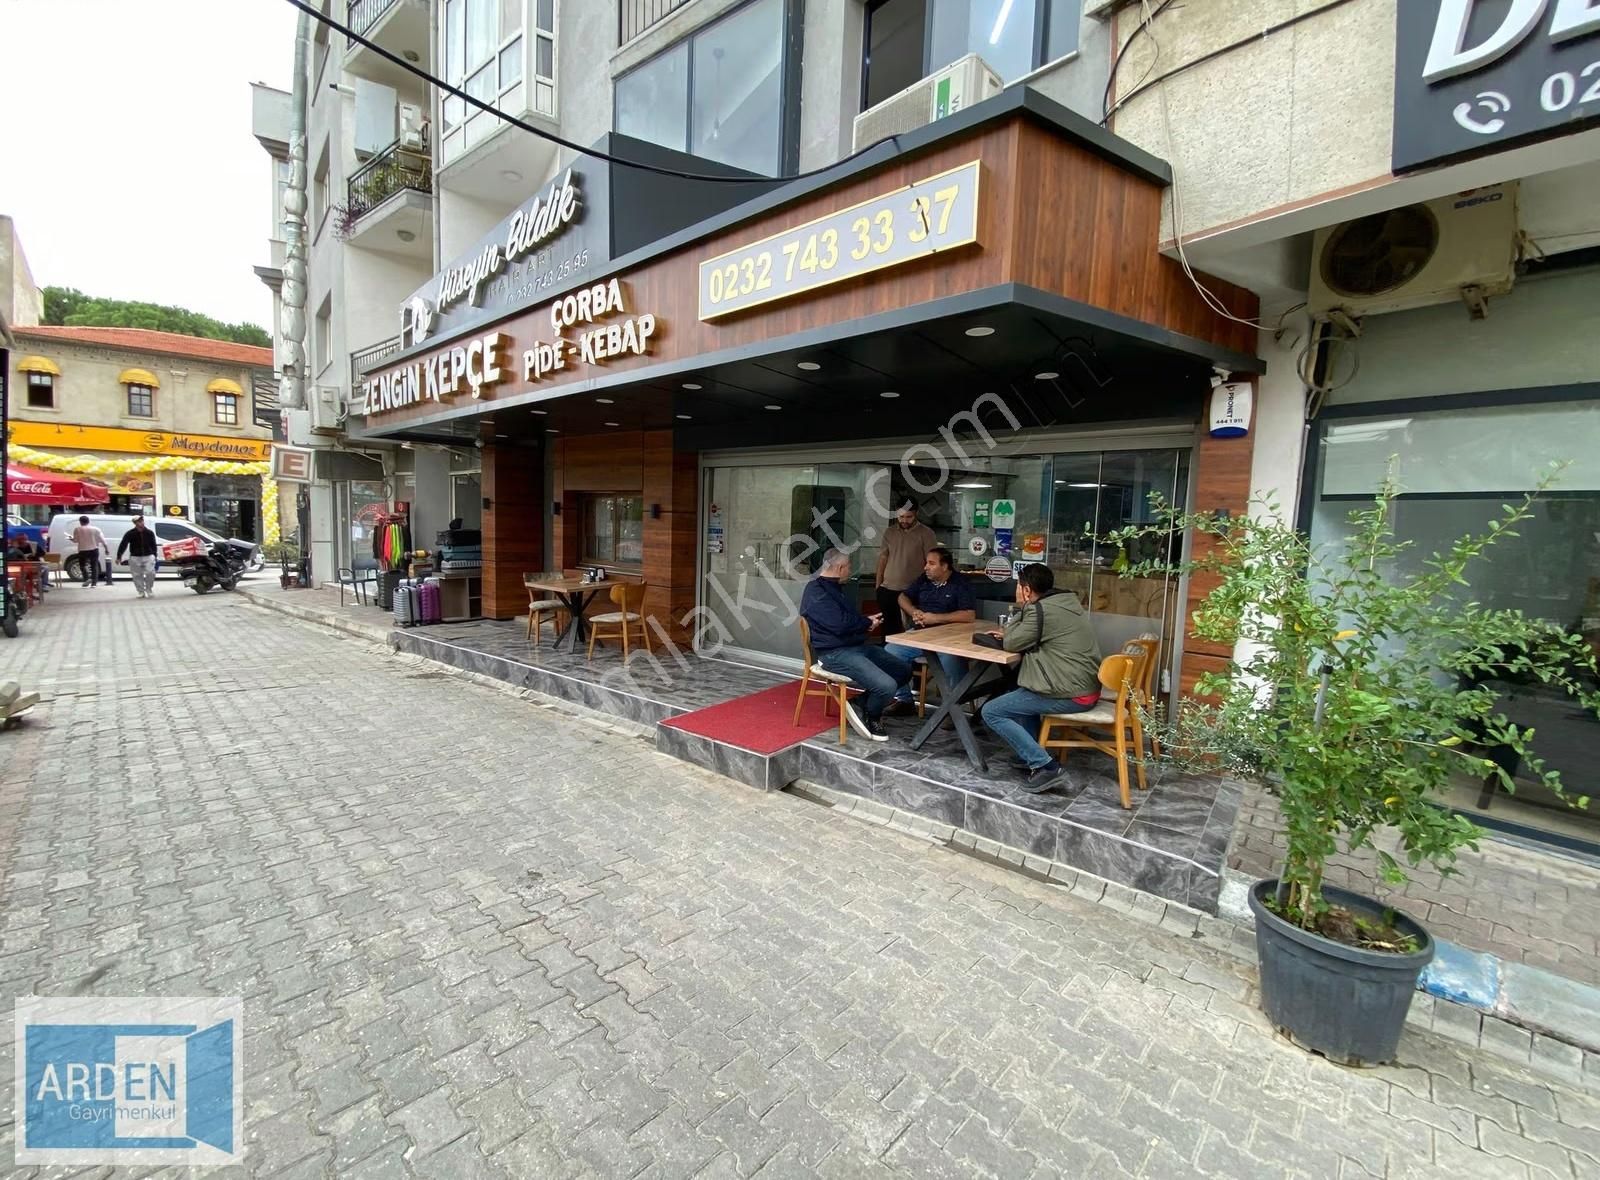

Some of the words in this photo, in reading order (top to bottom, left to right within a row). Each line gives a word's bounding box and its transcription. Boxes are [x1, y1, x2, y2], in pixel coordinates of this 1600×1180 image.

[505, 167, 576, 261] Bildik
[708, 251, 773, 304] 0232
[782, 227, 839, 282] 743
[851, 208, 894, 260] 33
[907, 183, 960, 243] 37
[550, 277, 625, 337] ÇORBA
[579, 313, 656, 366] KEBAP
[423, 332, 501, 403] KEPÇE
[283, 454, 305, 476] E
